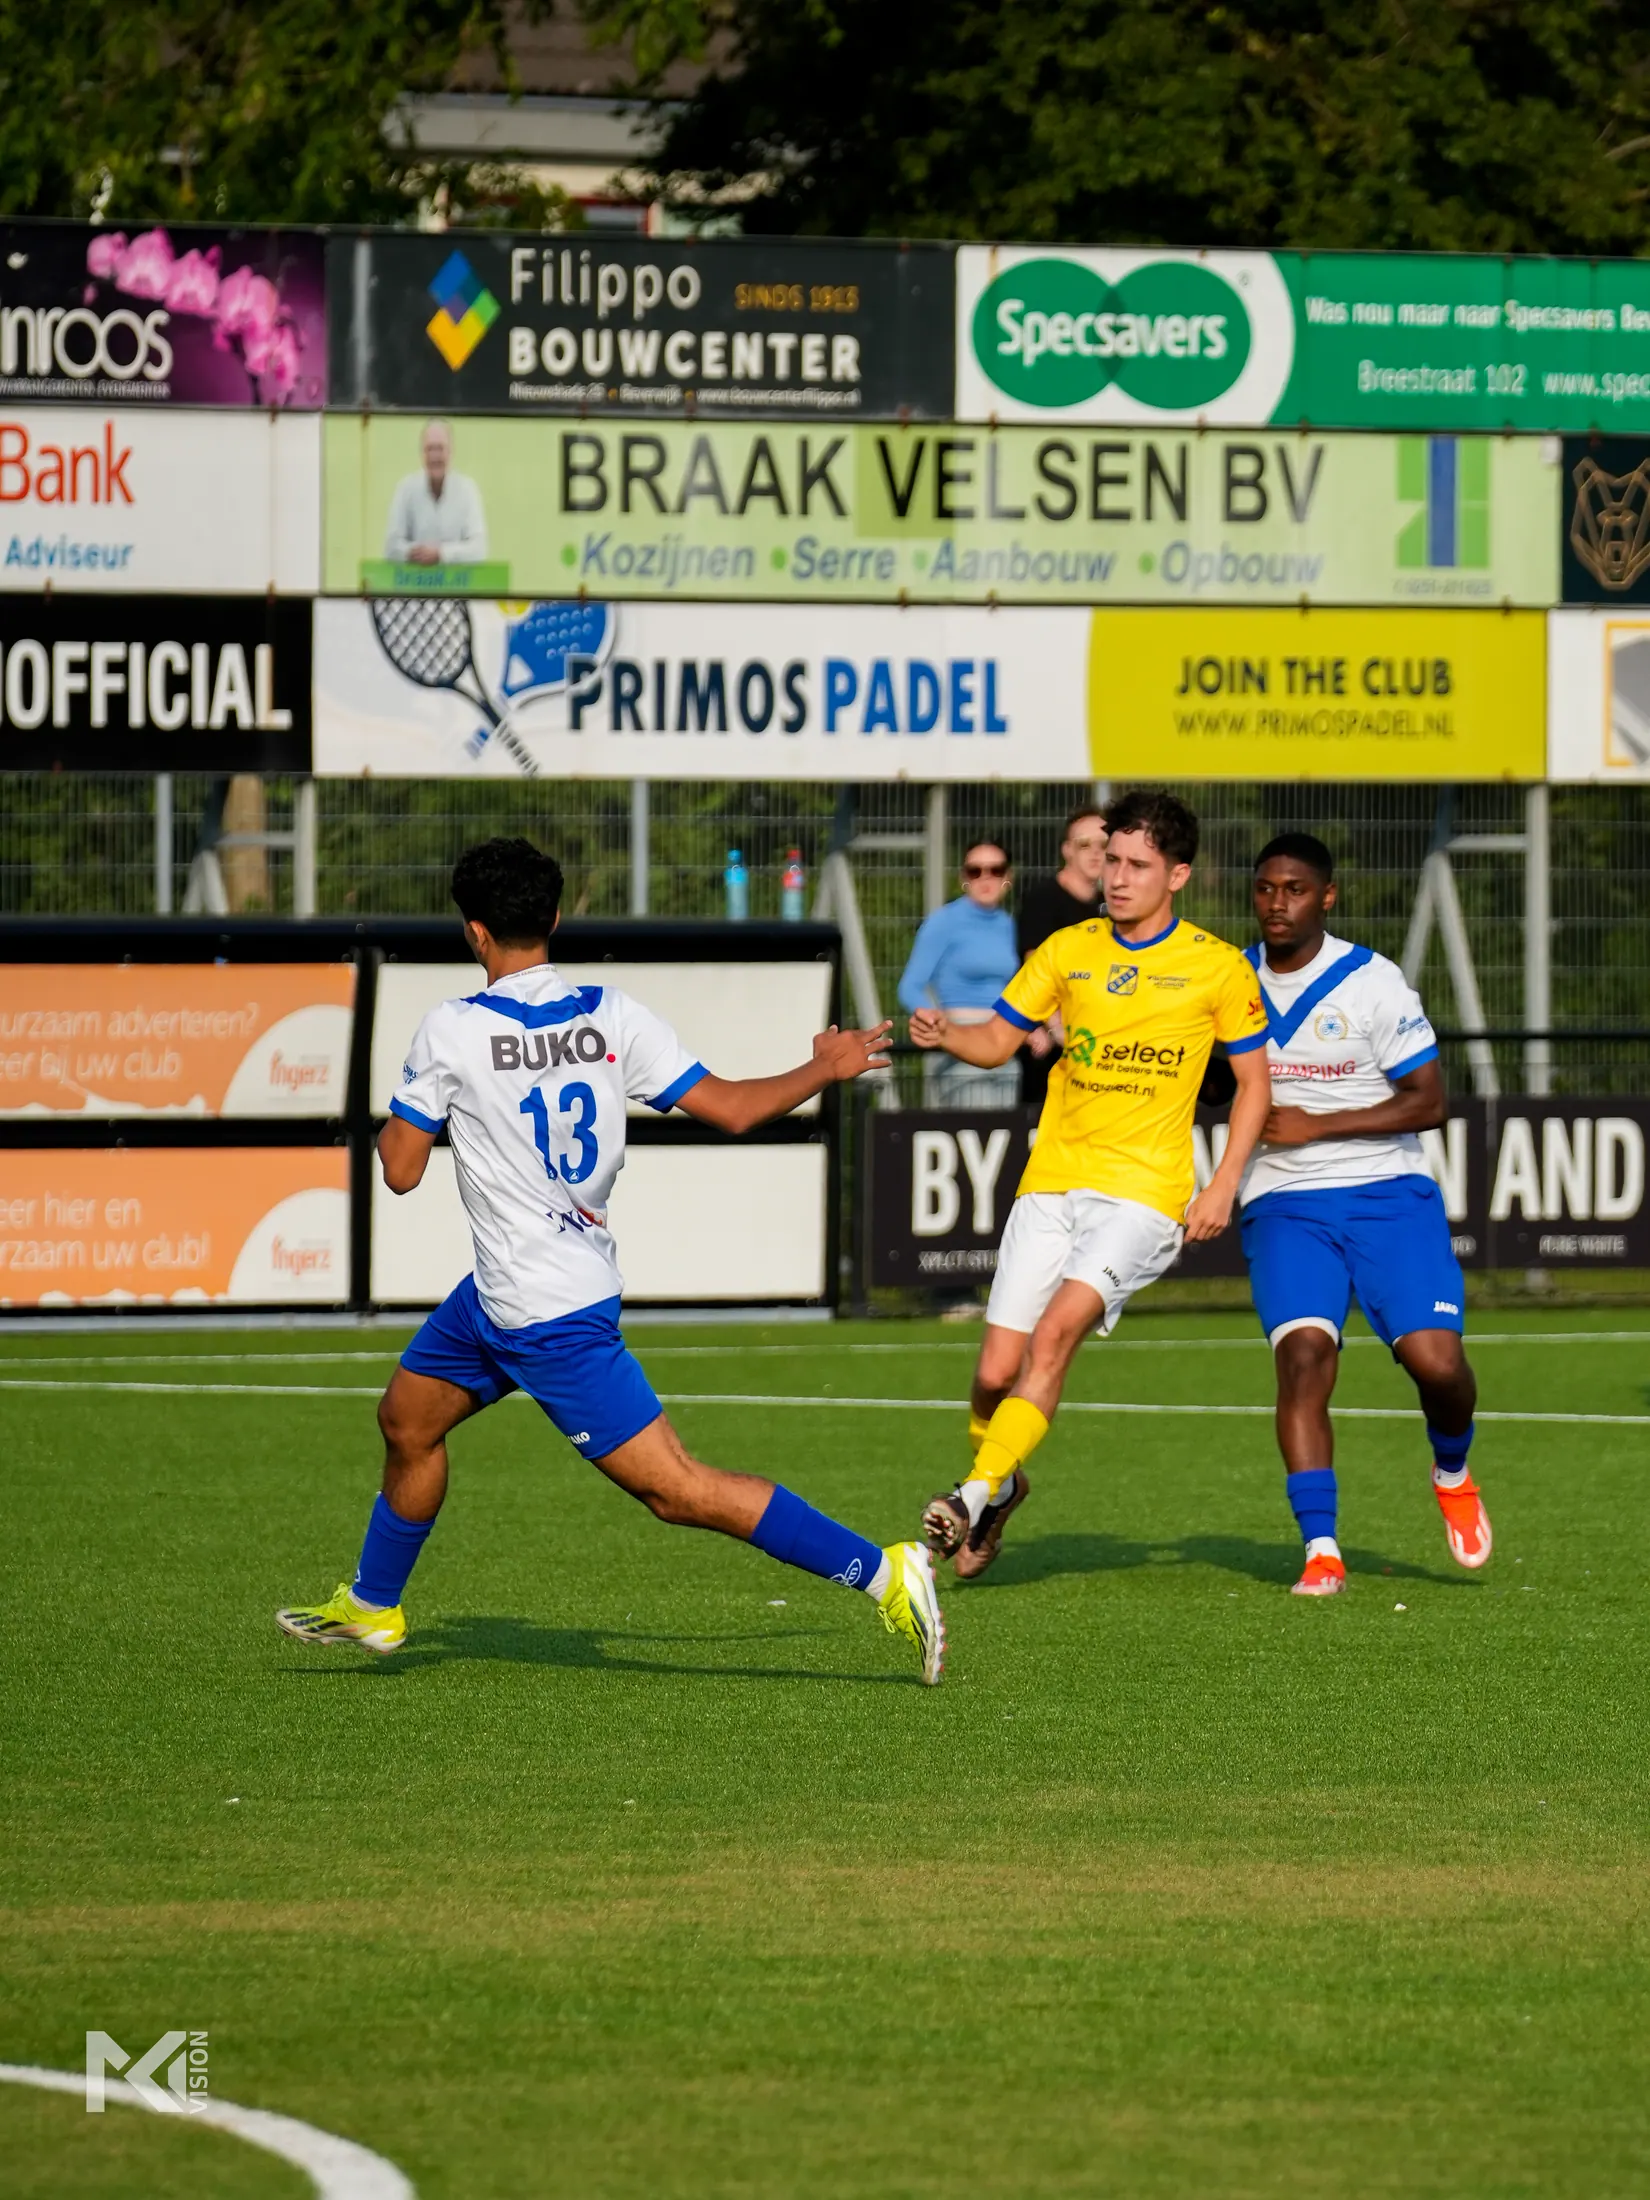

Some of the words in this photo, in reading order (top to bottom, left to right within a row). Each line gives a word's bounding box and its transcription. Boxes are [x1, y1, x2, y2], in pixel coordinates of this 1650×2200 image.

[509, 247, 701, 319] Filippo
[996, 298, 1228, 369] Specsavers
[1305, 296, 1348, 326] Was
[1352, 302, 1394, 326] nou
[1398, 303, 1450, 328] maar
[1454, 304, 1500, 329] naar
[1504, 299, 1616, 335] Specsavers
[1620, 302, 1650, 333] Be
[509, 325, 862, 383] BOUWCENTER
[1357, 360, 1476, 396] Breestraat
[1484, 363, 1529, 397] 102
[0, 420, 134, 505] Bank
[559, 432, 850, 517] BRAAK
[876, 436, 1189, 523] VELSEN
[1223, 445, 1325, 524] BV
[4, 532, 134, 569] Adviseur
[581, 533, 755, 588] Kozijnen
[791, 535, 897, 581] Serre
[930, 538, 1118, 583] Aanbouw
[1160, 540, 1325, 592] Opbouw
[0, 638, 293, 731] OFFICIAL
[565, 653, 810, 734] PRIMOS
[823, 658, 1009, 734] PADEL
[1174, 655, 1269, 697] JOIN
[1282, 656, 1348, 697] THE
[1362, 656, 1454, 698] CLUB
[1174, 708, 1455, 740] WWW.PRIMOSPADEL.NL
[106, 1001, 259, 1041] adverteren?
[76, 1052, 119, 1081] uw
[123, 1046, 182, 1081] club
[490, 1026, 616, 1071] BUKO.
[1101, 1041, 1185, 1066] select
[519, 1081, 599, 1184] 13
[912, 1129, 1011, 1237] BY
[1488, 1116, 1646, 1222] AND
[44, 1189, 96, 1229] hier
[104, 1197, 142, 1229] en
[92, 1240, 139, 1270] uw
